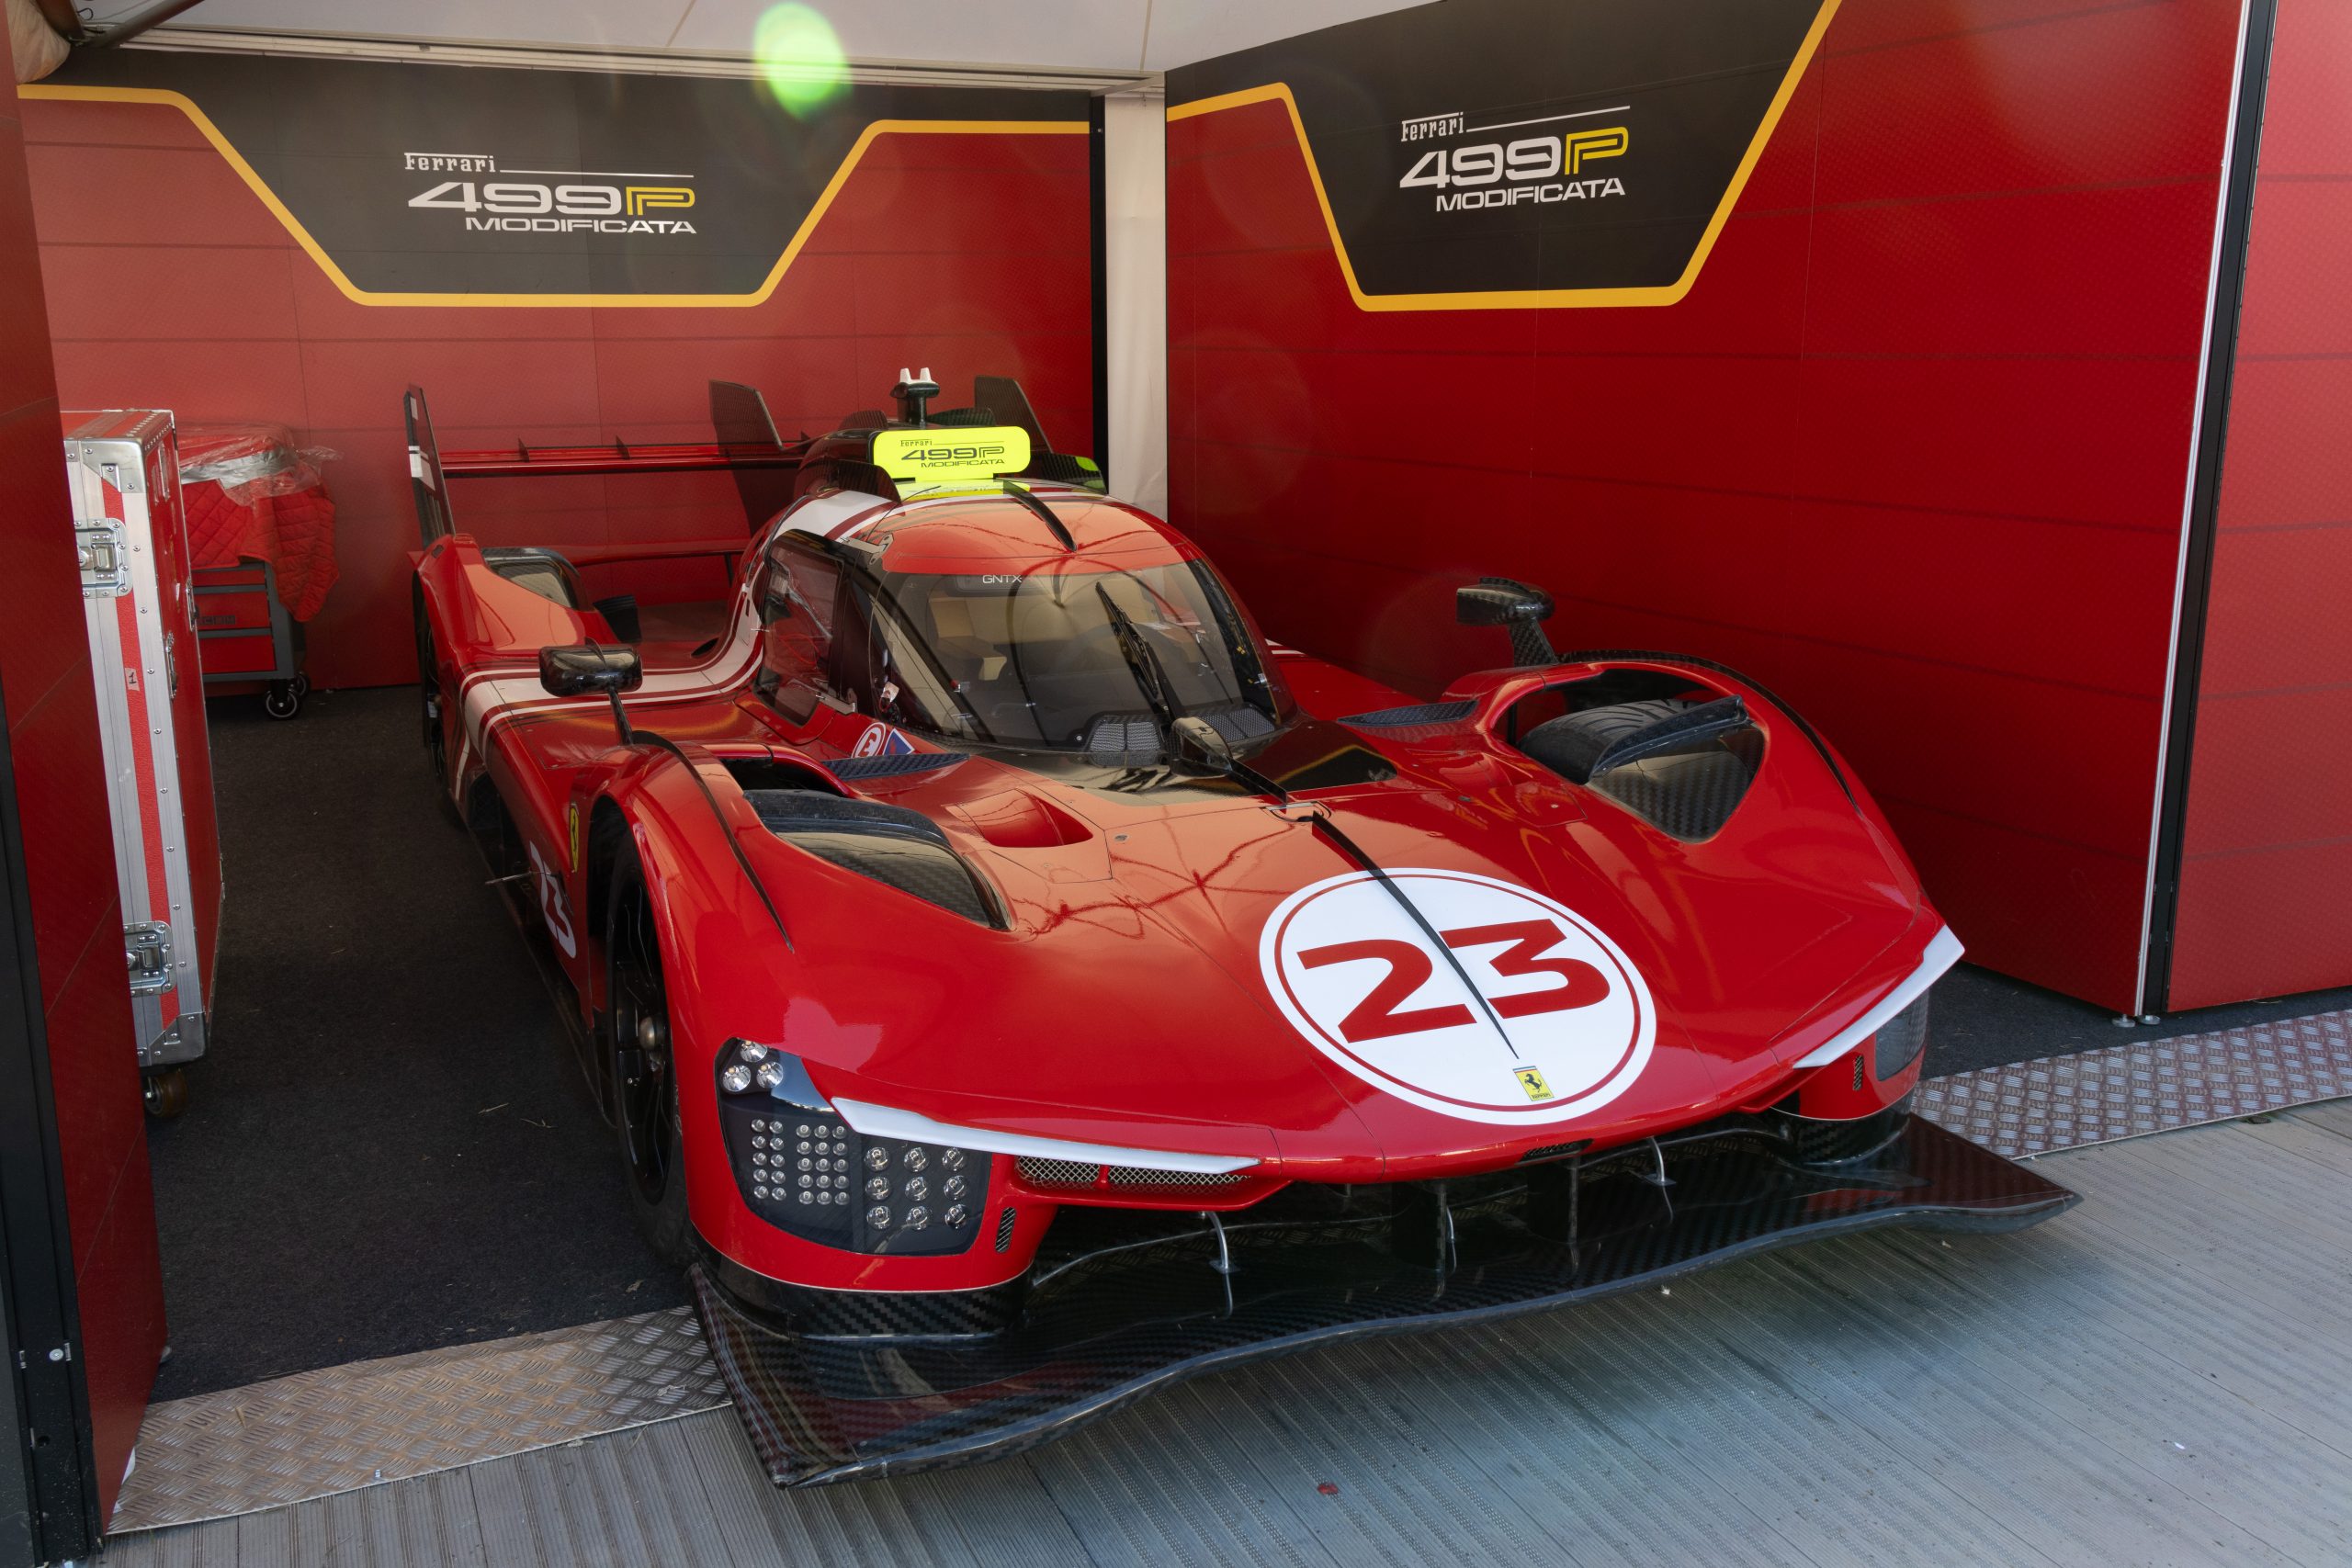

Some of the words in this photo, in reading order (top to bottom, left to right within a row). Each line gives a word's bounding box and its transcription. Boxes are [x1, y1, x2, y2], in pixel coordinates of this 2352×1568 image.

[1400, 112, 1464, 142] Ferrari
[404, 152, 496, 173] Ferrari
[1399, 126, 1629, 188] 499P
[408, 182, 695, 216] 499P
[1436, 177, 1625, 211] MODIFICATA
[465, 217, 697, 234] MODIFICATA
[902, 446, 1005, 461] 499P
[921, 458, 1005, 468] MODIFICATA
[982, 574, 1023, 584] GNTX
[129, 671, 137, 684] 1
[1296, 918, 1611, 1043] 23
